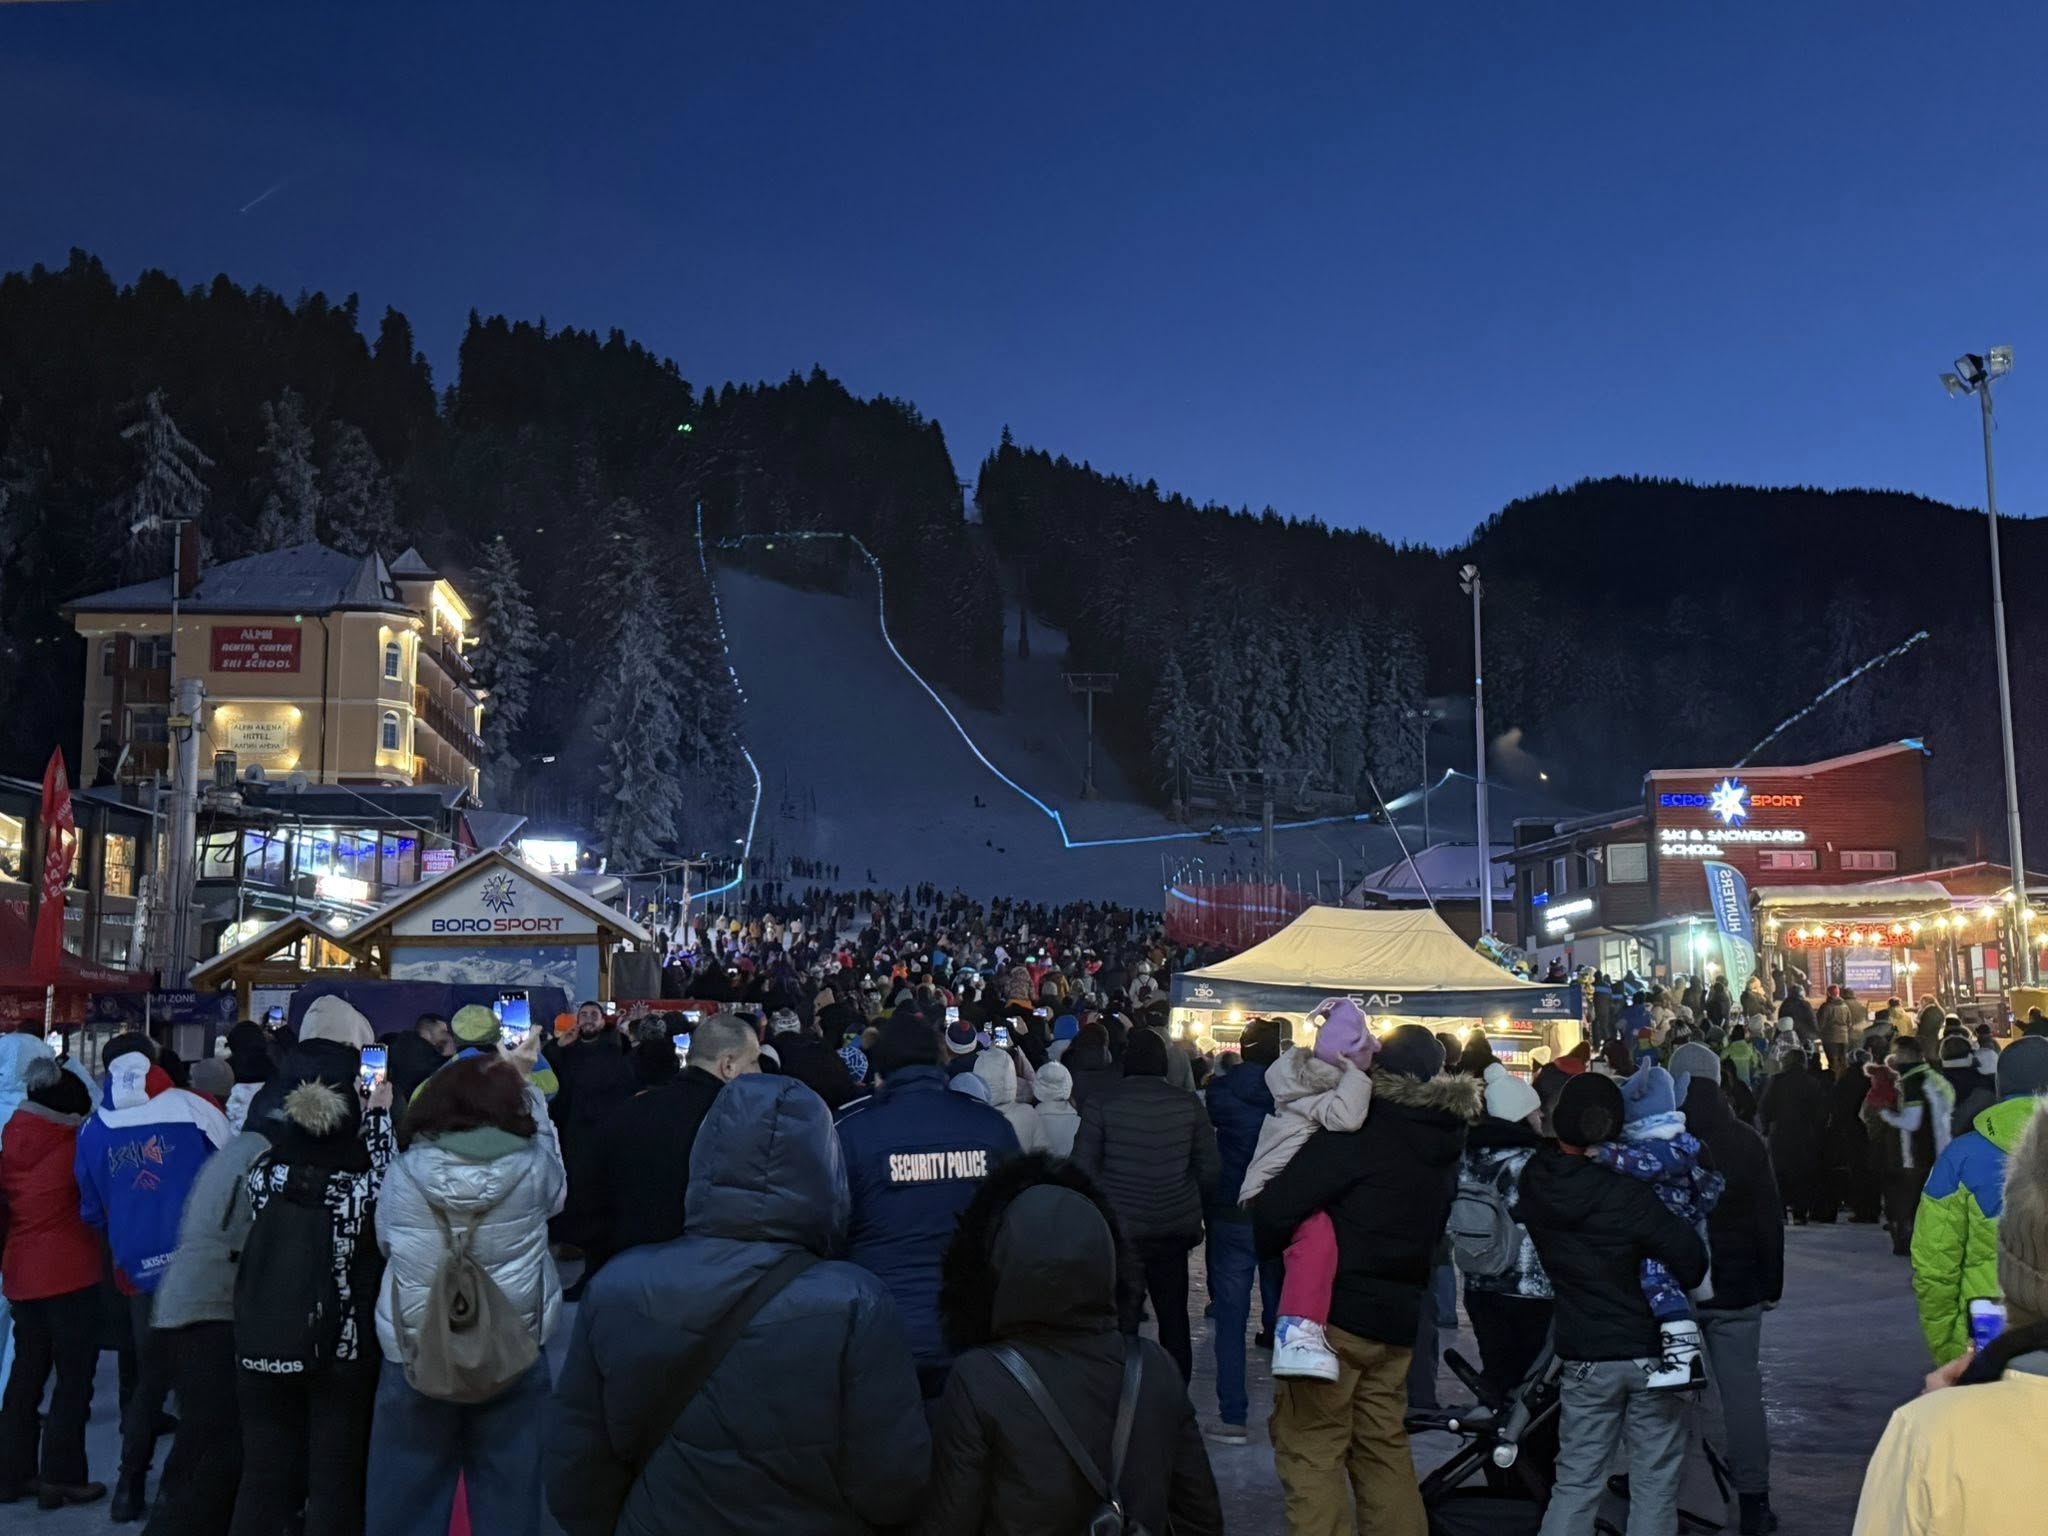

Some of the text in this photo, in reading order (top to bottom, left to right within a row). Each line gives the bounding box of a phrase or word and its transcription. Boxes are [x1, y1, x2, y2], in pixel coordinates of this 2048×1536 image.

[222, 659, 290, 668] SKI SCHOOL
[1750, 794, 1804, 807] SPORT
[1660, 829, 1687, 841] SKI
[1707, 830, 1806, 842] SNOWBOARD
[1660, 844, 1725, 856] SCHOOL
[432, 917, 564, 932] BORO SPORT
[168, 993, 196, 1004] ZONE
[1540, 998, 1562, 1008] 130
[888, 1150, 988, 1182] SECURITY POLICE
[242, 1357, 304, 1374] adidas
